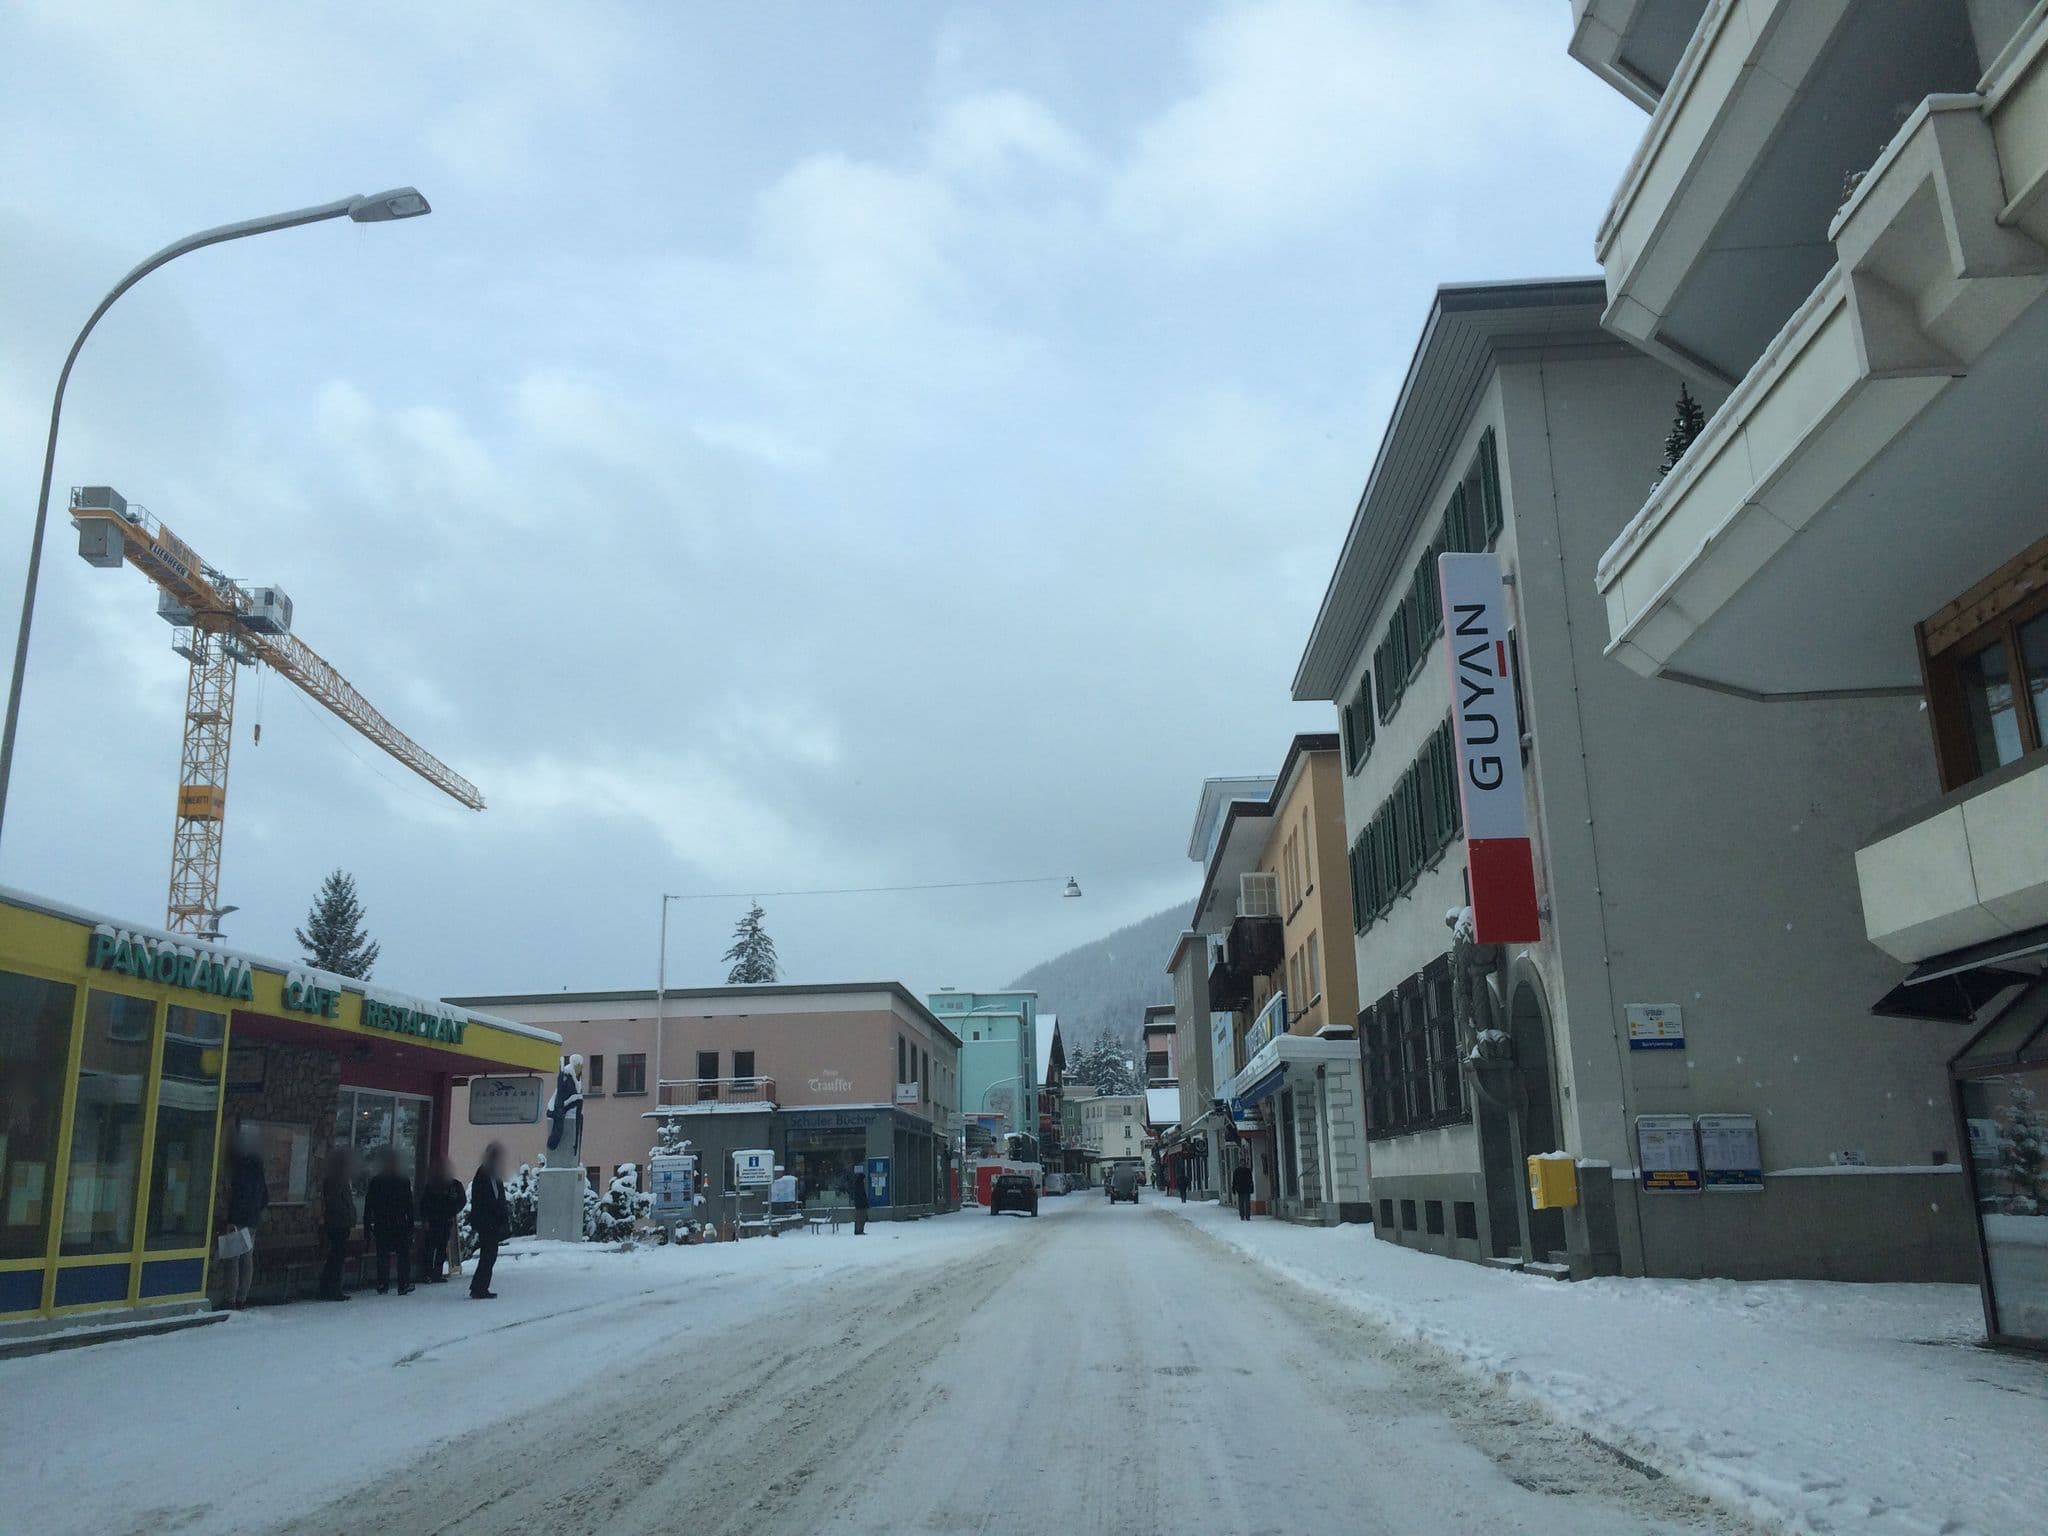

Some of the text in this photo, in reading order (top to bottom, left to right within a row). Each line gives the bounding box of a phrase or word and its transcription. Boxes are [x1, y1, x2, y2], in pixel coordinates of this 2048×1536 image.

[152, 544, 187, 577] LIEBHERR
[1453, 604, 1507, 790] GUYAN
[92, 932, 254, 1000] PANORAMA
[366, 999, 467, 1044] RESTAURANT
